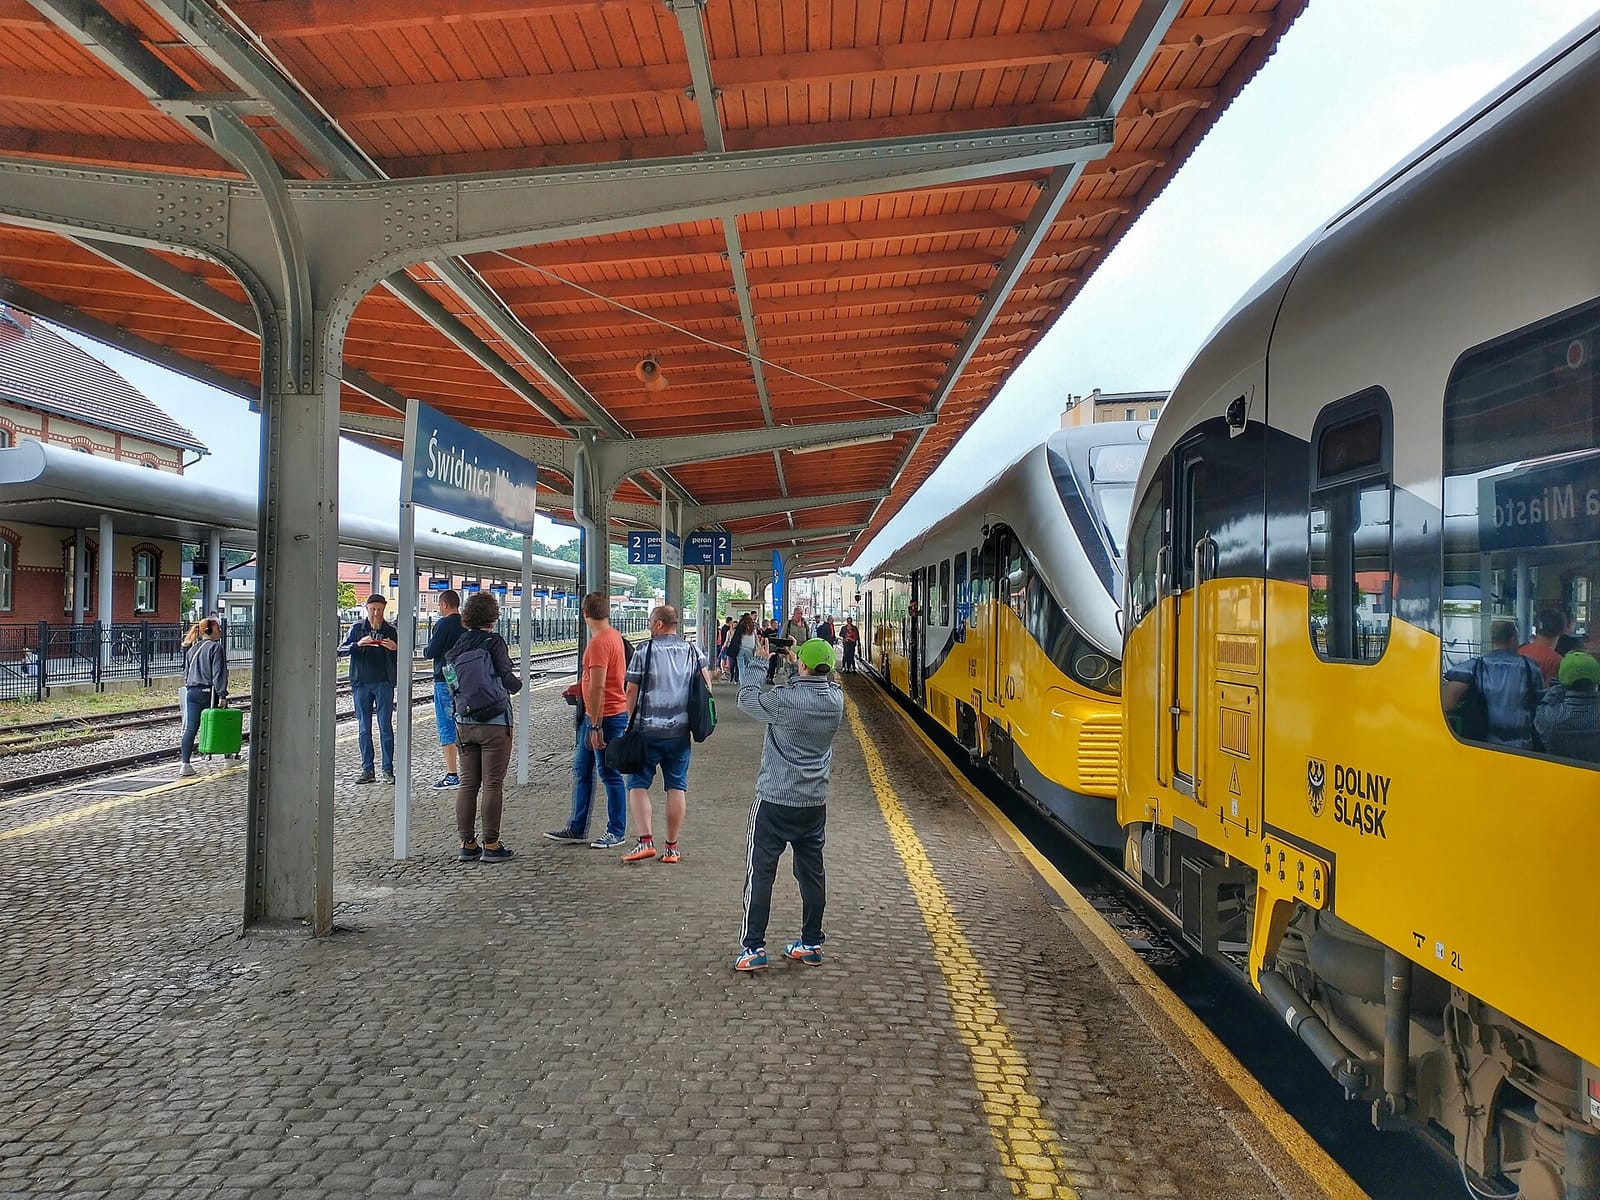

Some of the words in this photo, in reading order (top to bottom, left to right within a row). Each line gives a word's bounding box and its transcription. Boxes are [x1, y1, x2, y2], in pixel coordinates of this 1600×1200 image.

[426, 429, 491, 498] Świdnica
[633, 536, 641, 548] 2
[718, 537, 727, 549] 2
[633, 552, 641, 562] 2
[719, 553, 725, 563] 1
[1334, 763, 1391, 806] DOLNY
[1333, 789, 1387, 840] ŚLĄSK
[1451, 950, 1464, 972] 2L
